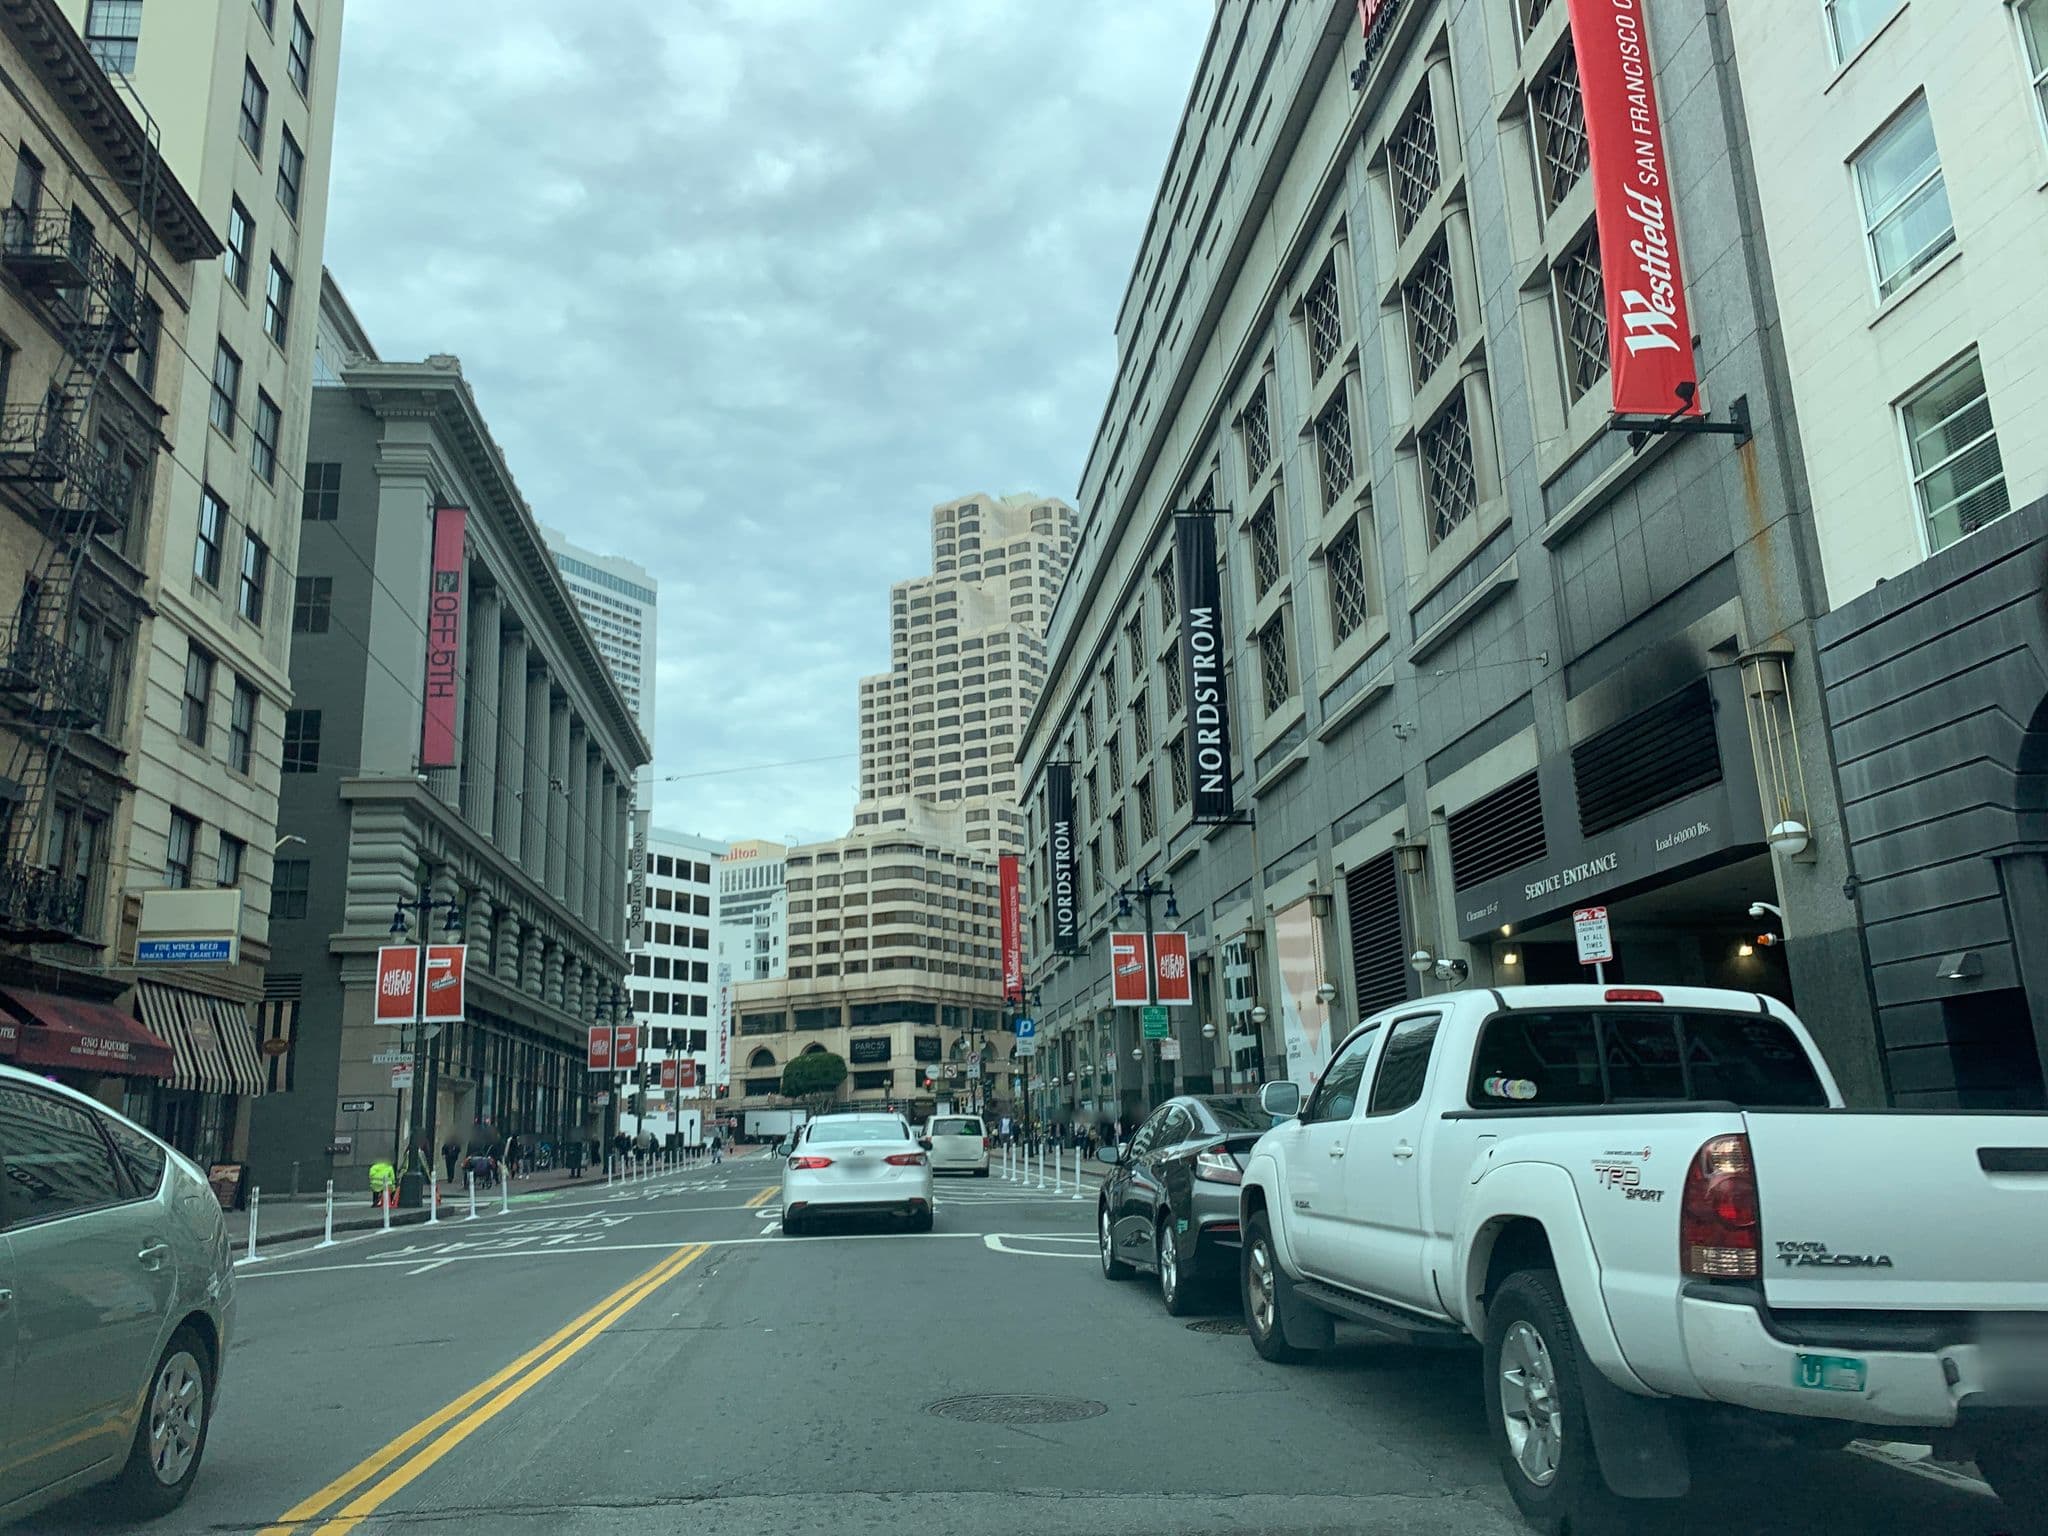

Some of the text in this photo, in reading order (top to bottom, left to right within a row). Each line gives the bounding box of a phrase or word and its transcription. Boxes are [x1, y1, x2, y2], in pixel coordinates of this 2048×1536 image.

[1616, 14, 1653, 136] FRANCISCO
[1636, 139, 1659, 187] SAN
[1621, 183, 1681, 358] Westfield
[432, 596, 458, 644] OFF
[429, 649, 456, 698] 5TH
[1190, 607, 1224, 793] NORDSTROM
[1655, 838, 1673, 852] Load
[1697, 821, 1711, 835] lbs.
[631, 832, 644, 928] NORDSTROM rack
[1054, 821, 1073, 936] NORDSTROM
[1525, 852, 1618, 900] SERVICE ENTRANCE
[172, 943, 196, 951] WINES
[1586, 941, 1603, 949] TIMES
[1005, 948, 1019, 988] Westfield
[1160, 953, 1185, 968] AHEAD
[1160, 966, 1185, 980] CURVE
[382, 981, 411, 997] CURVE
[383, 968, 413, 984] AHEAD
[100, 1038, 129, 1052] LIQUORS
[1595, 1165, 1640, 1190] TRD
[1625, 1188, 1664, 1202] SPORT
[1776, 1241, 1827, 1252] TOYOTA
[1776, 1253, 1893, 1267] TACOMA
